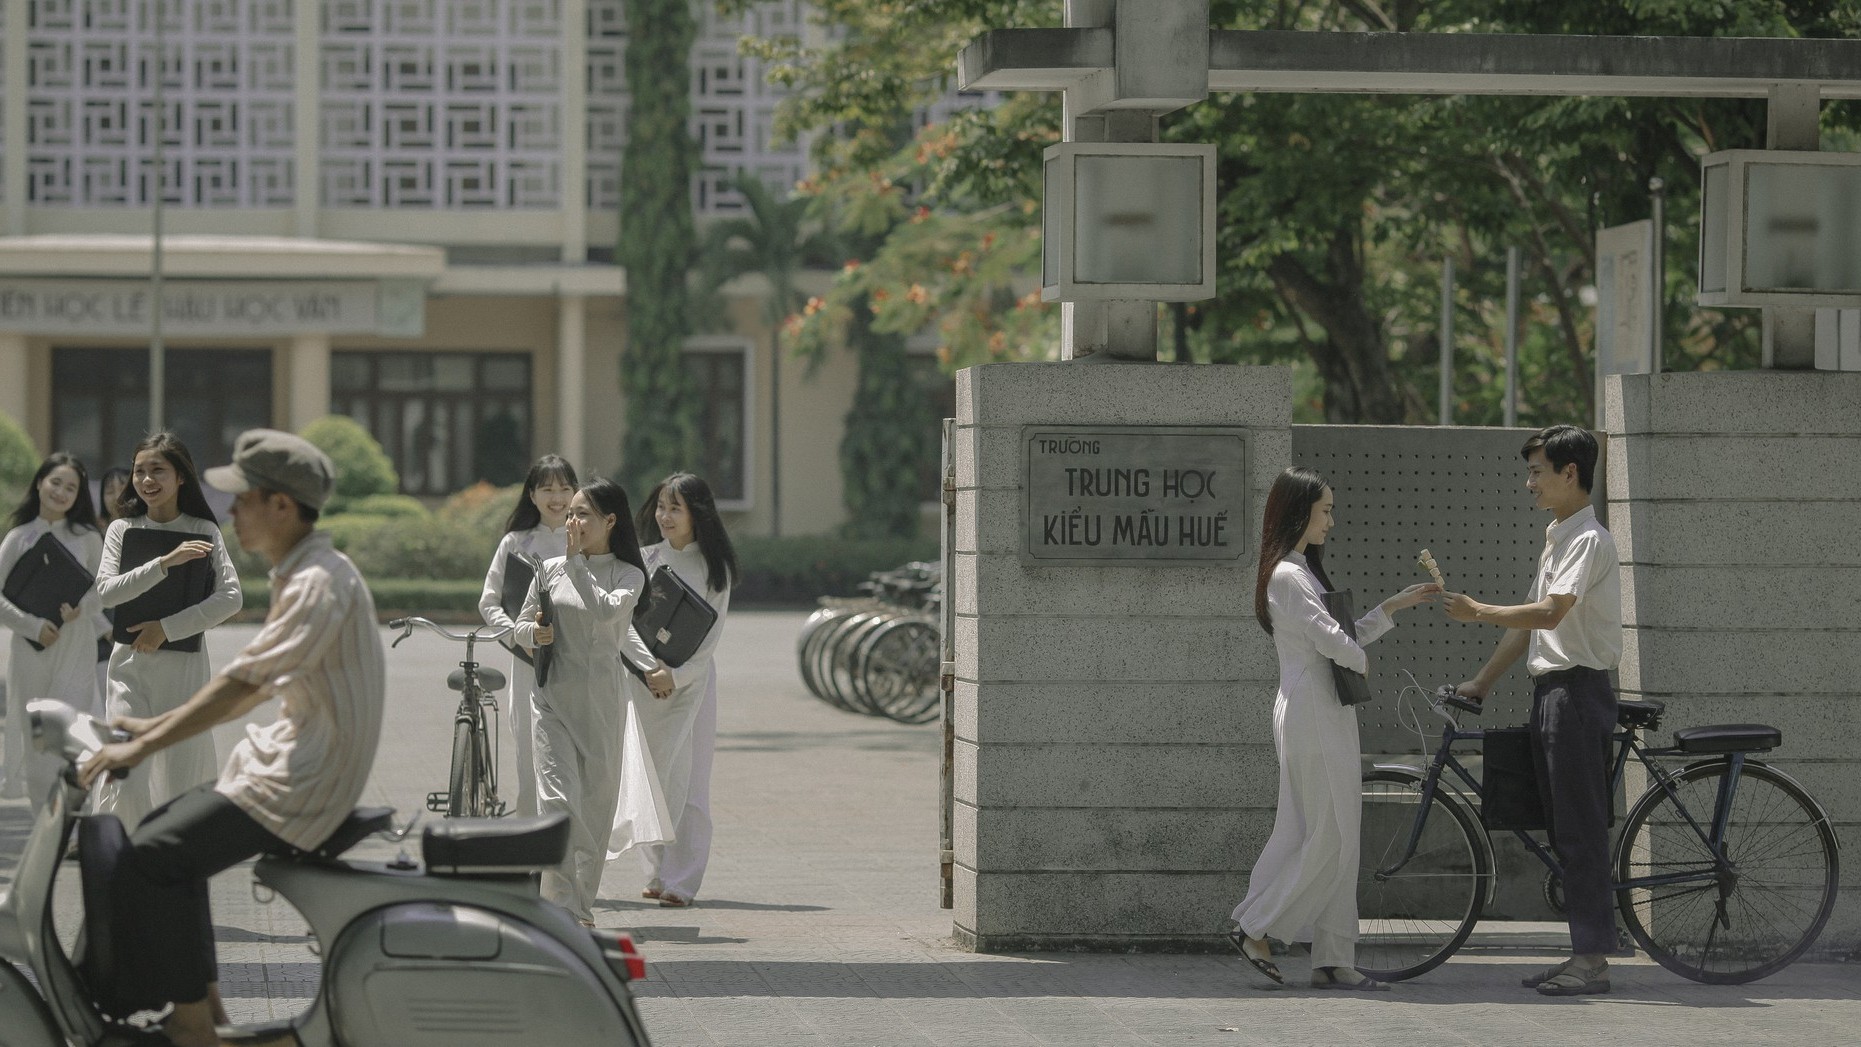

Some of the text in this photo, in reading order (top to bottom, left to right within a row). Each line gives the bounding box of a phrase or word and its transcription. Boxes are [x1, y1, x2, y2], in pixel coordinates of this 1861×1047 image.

[1065, 468, 1216, 504] TRUNG HỌC
[1112, 508, 1169, 547] MẪU
[1178, 509, 1228, 547] HUẾ
